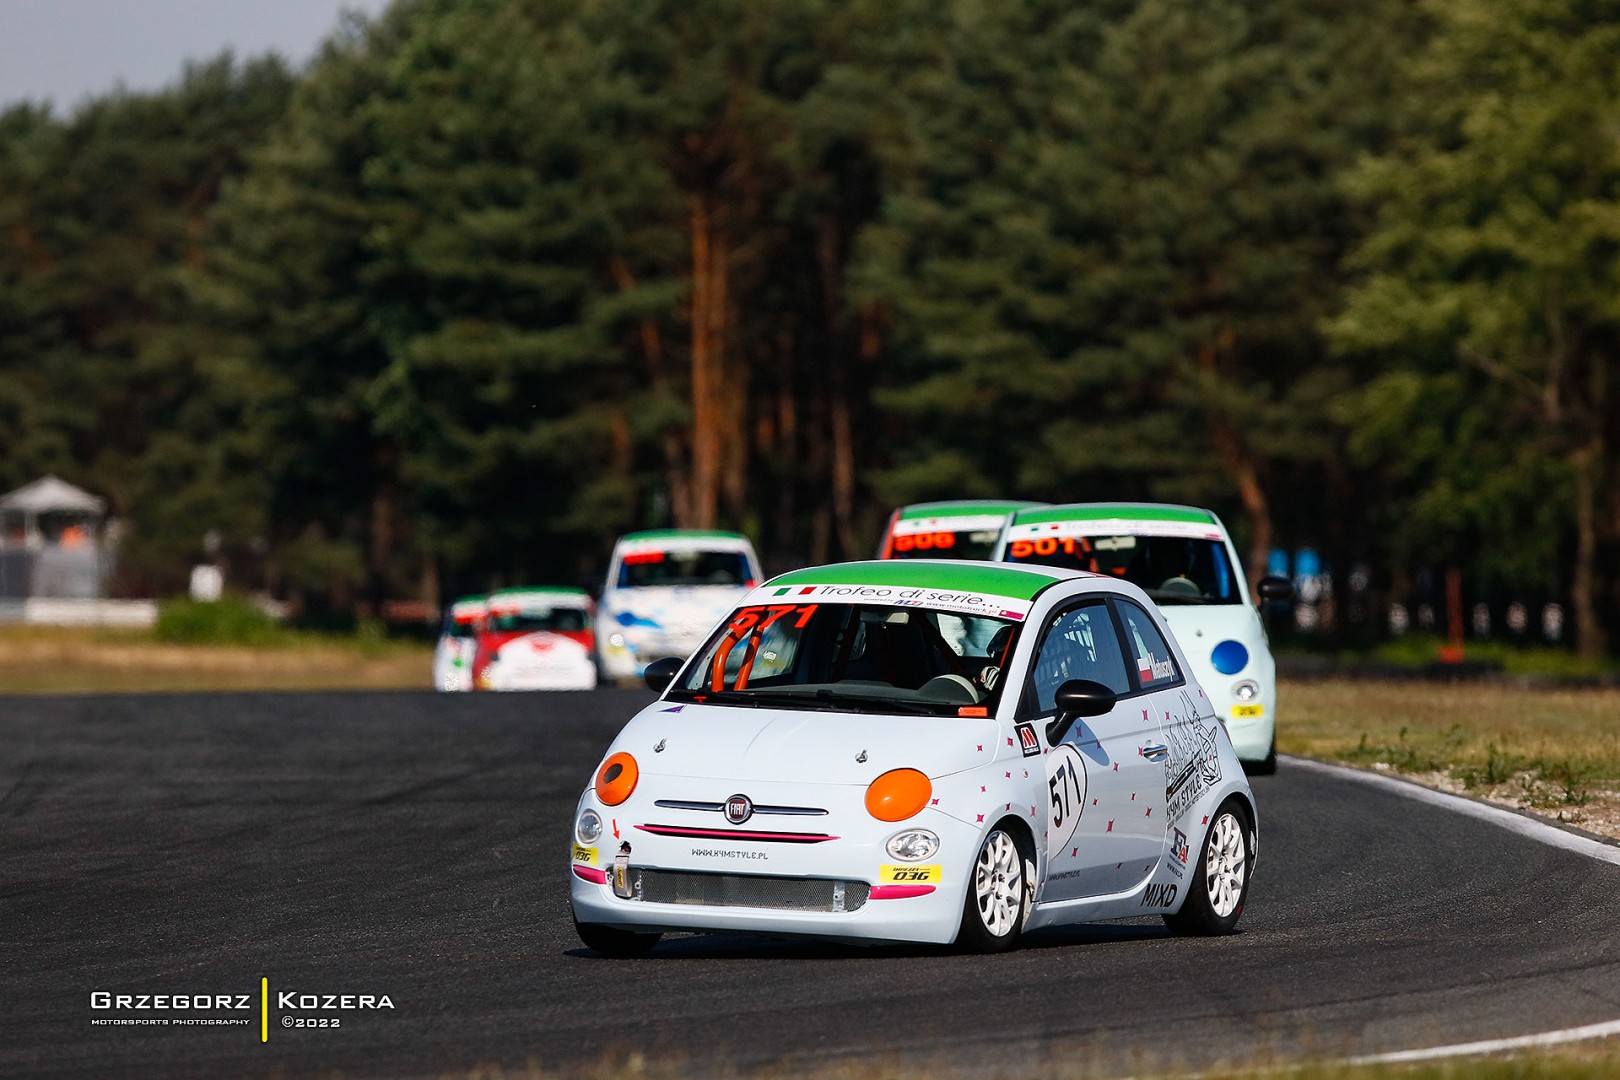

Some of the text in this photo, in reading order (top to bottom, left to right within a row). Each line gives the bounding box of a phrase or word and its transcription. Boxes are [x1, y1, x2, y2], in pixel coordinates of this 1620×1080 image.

[1011, 536, 1076, 558] 501
[820, 585, 892, 597] Trofeo
[899, 589, 926, 600] di
[926, 593, 1000, 609] serie...
[728, 604, 819, 630] 571
[1049, 755, 1082, 828] 571
[730, 803, 746, 815] FIAT
[1140, 883, 1178, 907] MIXD
